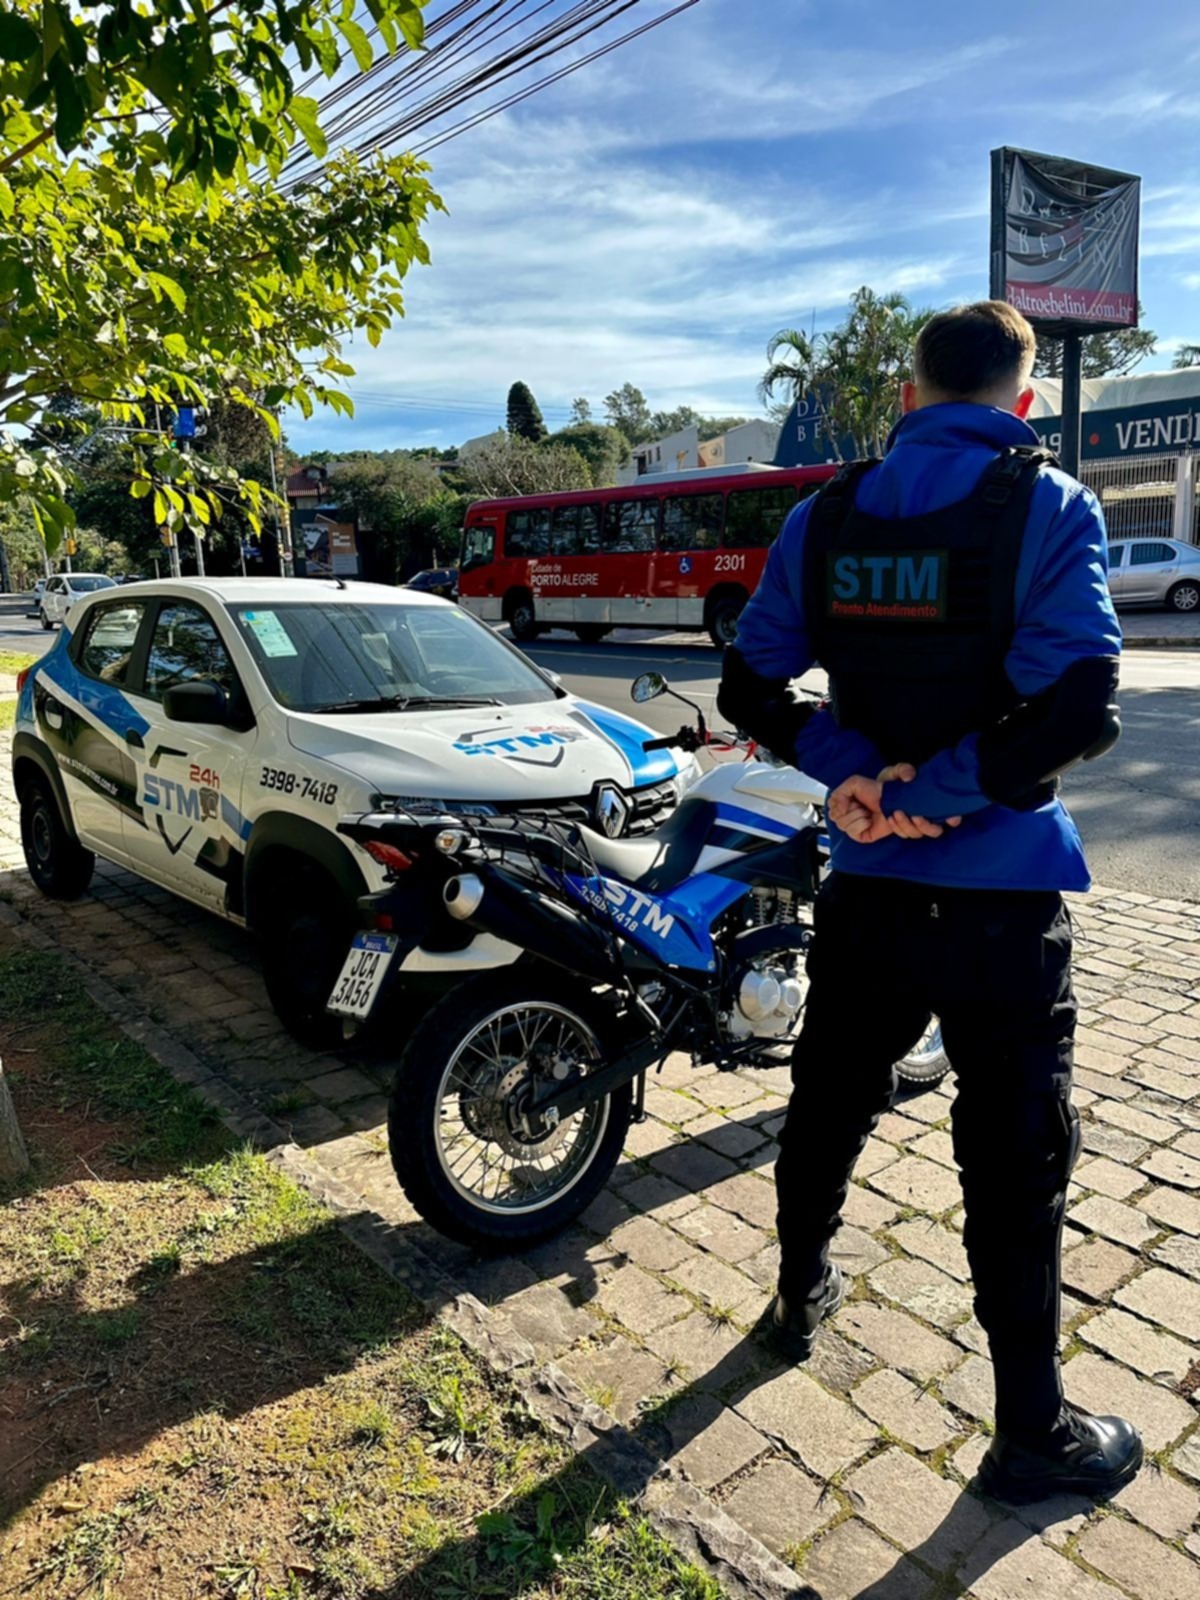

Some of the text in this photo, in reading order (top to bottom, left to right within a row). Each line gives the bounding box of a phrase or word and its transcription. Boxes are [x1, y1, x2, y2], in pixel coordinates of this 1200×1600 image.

[714, 554, 746, 571] 2301
[531, 573, 599, 586] PORTO ALEGRE
[833, 555, 940, 600] STM
[832, 601, 938, 617] Pronto Atendimento
[452, 732, 567, 756] STM
[190, 763, 220, 789] 24h
[260, 766, 338, 805] 3398-7418
[143, 772, 200, 821] STM
[604, 880, 676, 939] STM
[351, 951, 381, 980] JCA
[335, 977, 374, 1009] 3A56
